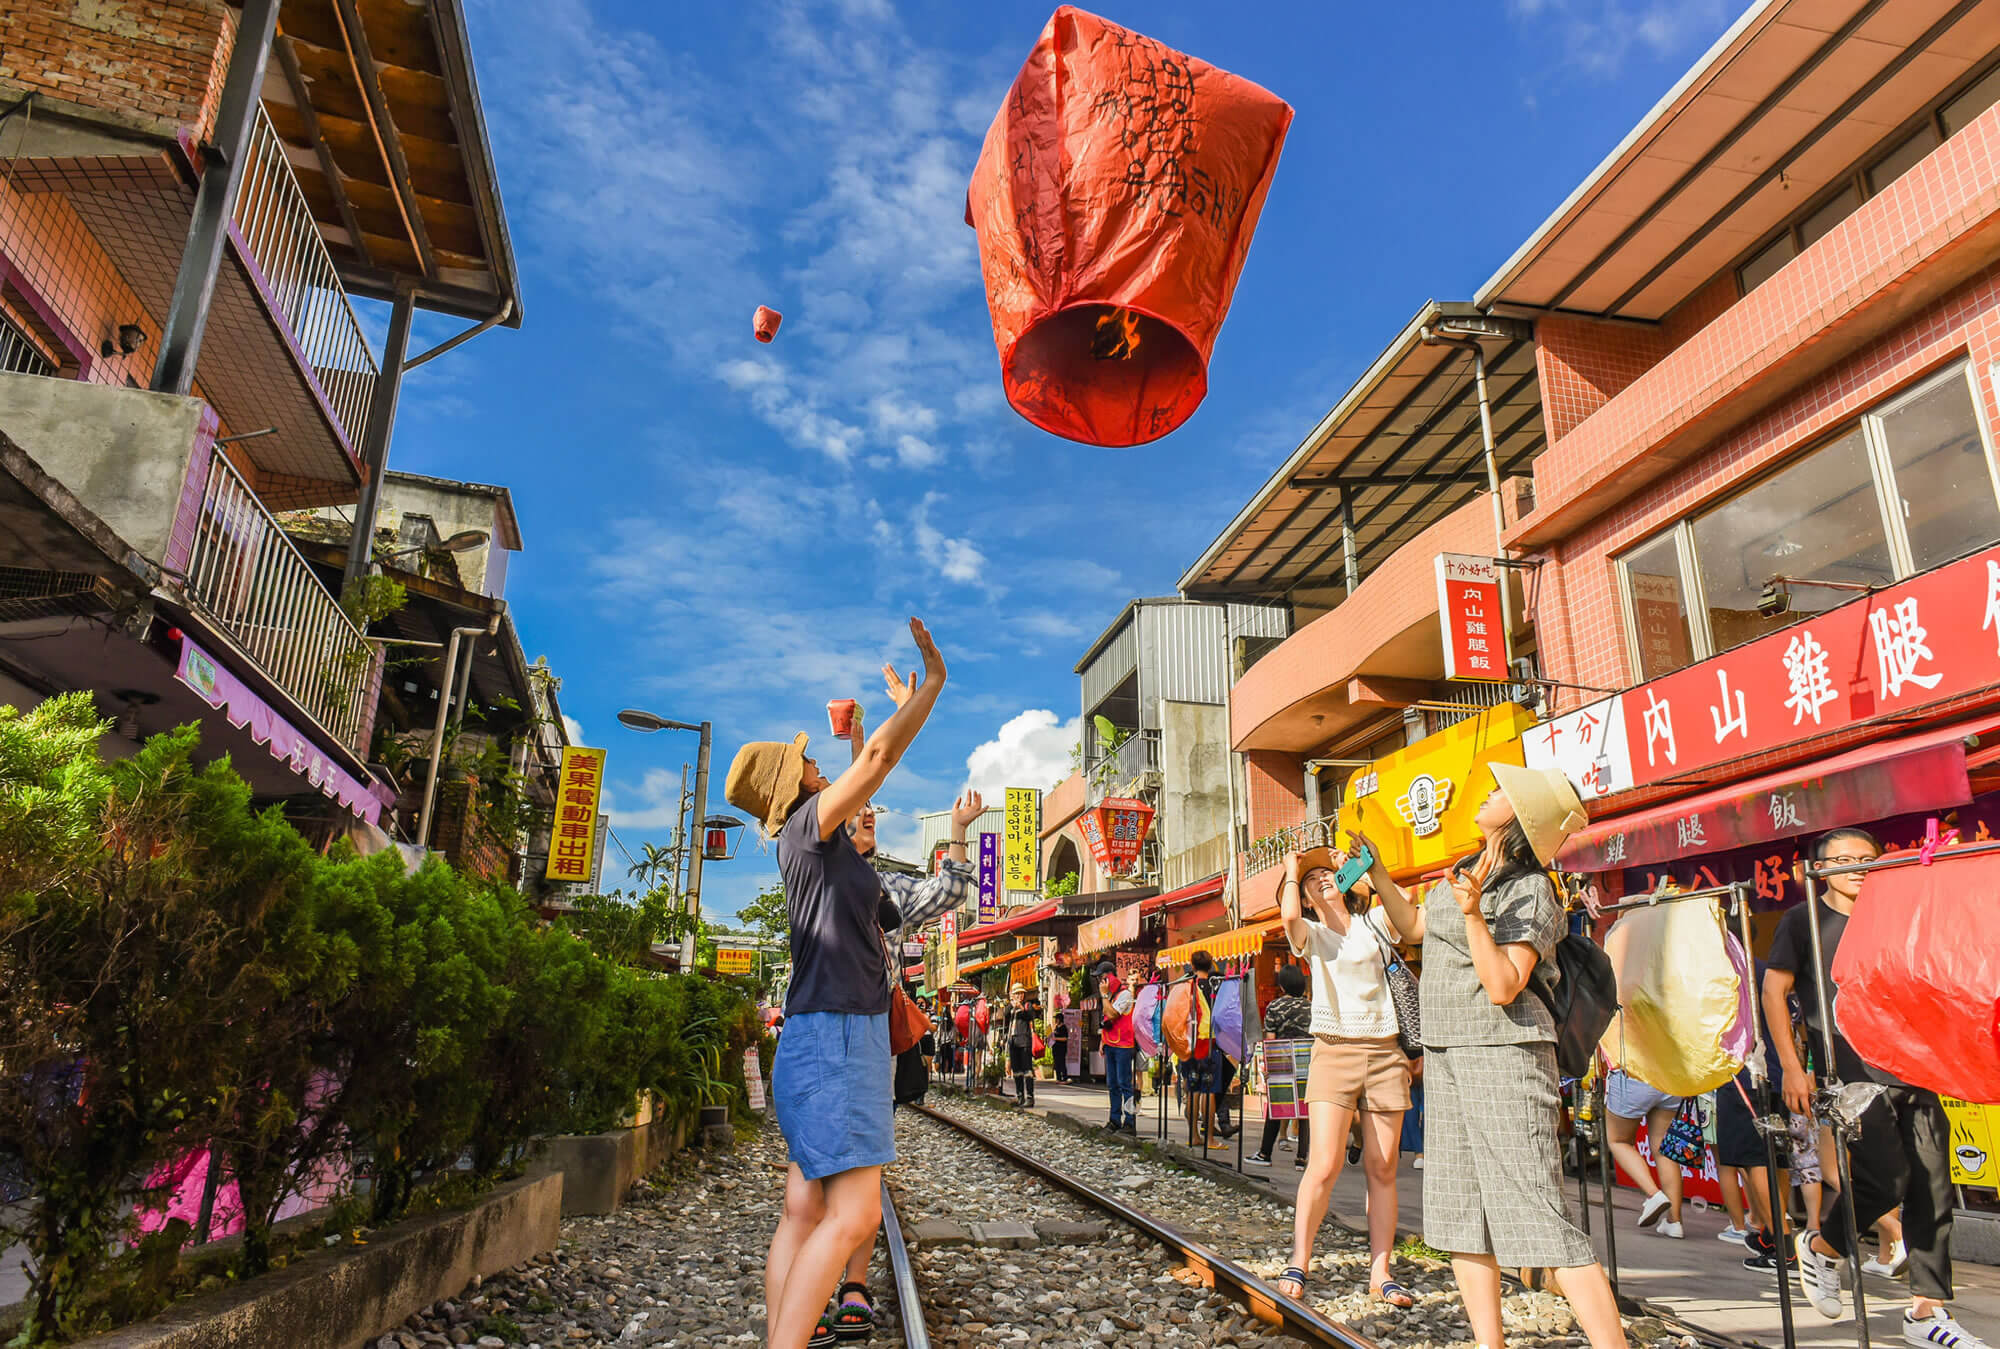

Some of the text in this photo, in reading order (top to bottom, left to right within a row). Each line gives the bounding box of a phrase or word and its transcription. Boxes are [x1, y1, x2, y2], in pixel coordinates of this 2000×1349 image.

[1445, 560, 1495, 579] 十分好吃
[1541, 711, 1600, 756] 十分
[1576, 761, 1609, 795] 吃
[554, 753, 599, 875] 美果電動車出租
[1007, 791, 1023, 880] 가용엄마 천등
[1415, 821, 1438, 836] DESIGN
[1605, 793, 1806, 866] 雞腿飯
